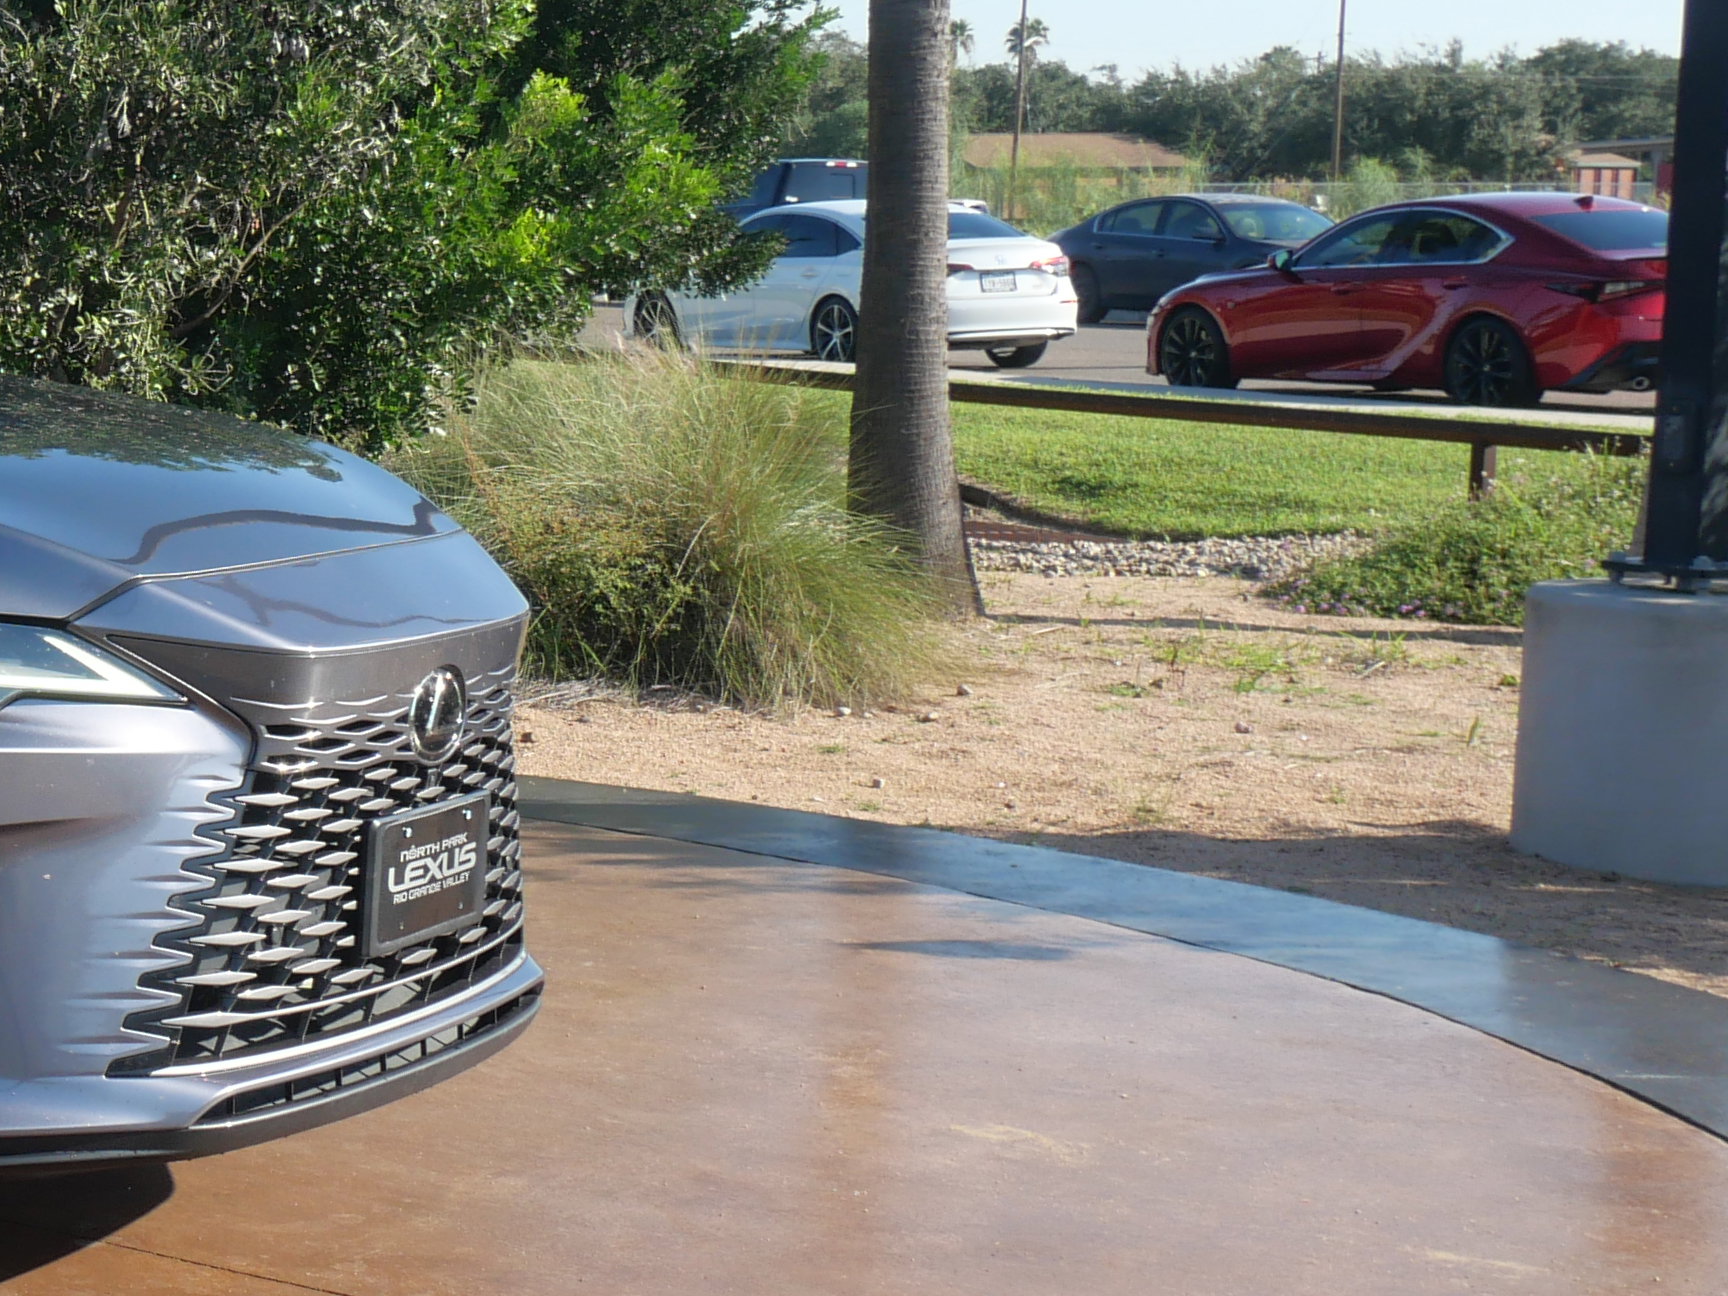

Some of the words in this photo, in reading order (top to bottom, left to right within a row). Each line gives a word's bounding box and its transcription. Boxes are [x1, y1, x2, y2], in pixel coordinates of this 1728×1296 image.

[400, 841, 440, 863] NORTH
[442, 832, 468, 851] PARK
[388, 841, 477, 893] LEXUS
[393, 891, 408, 905] RIO
[408, 881, 441, 900] GRANDE
[443, 871, 470, 889] VALLEY
